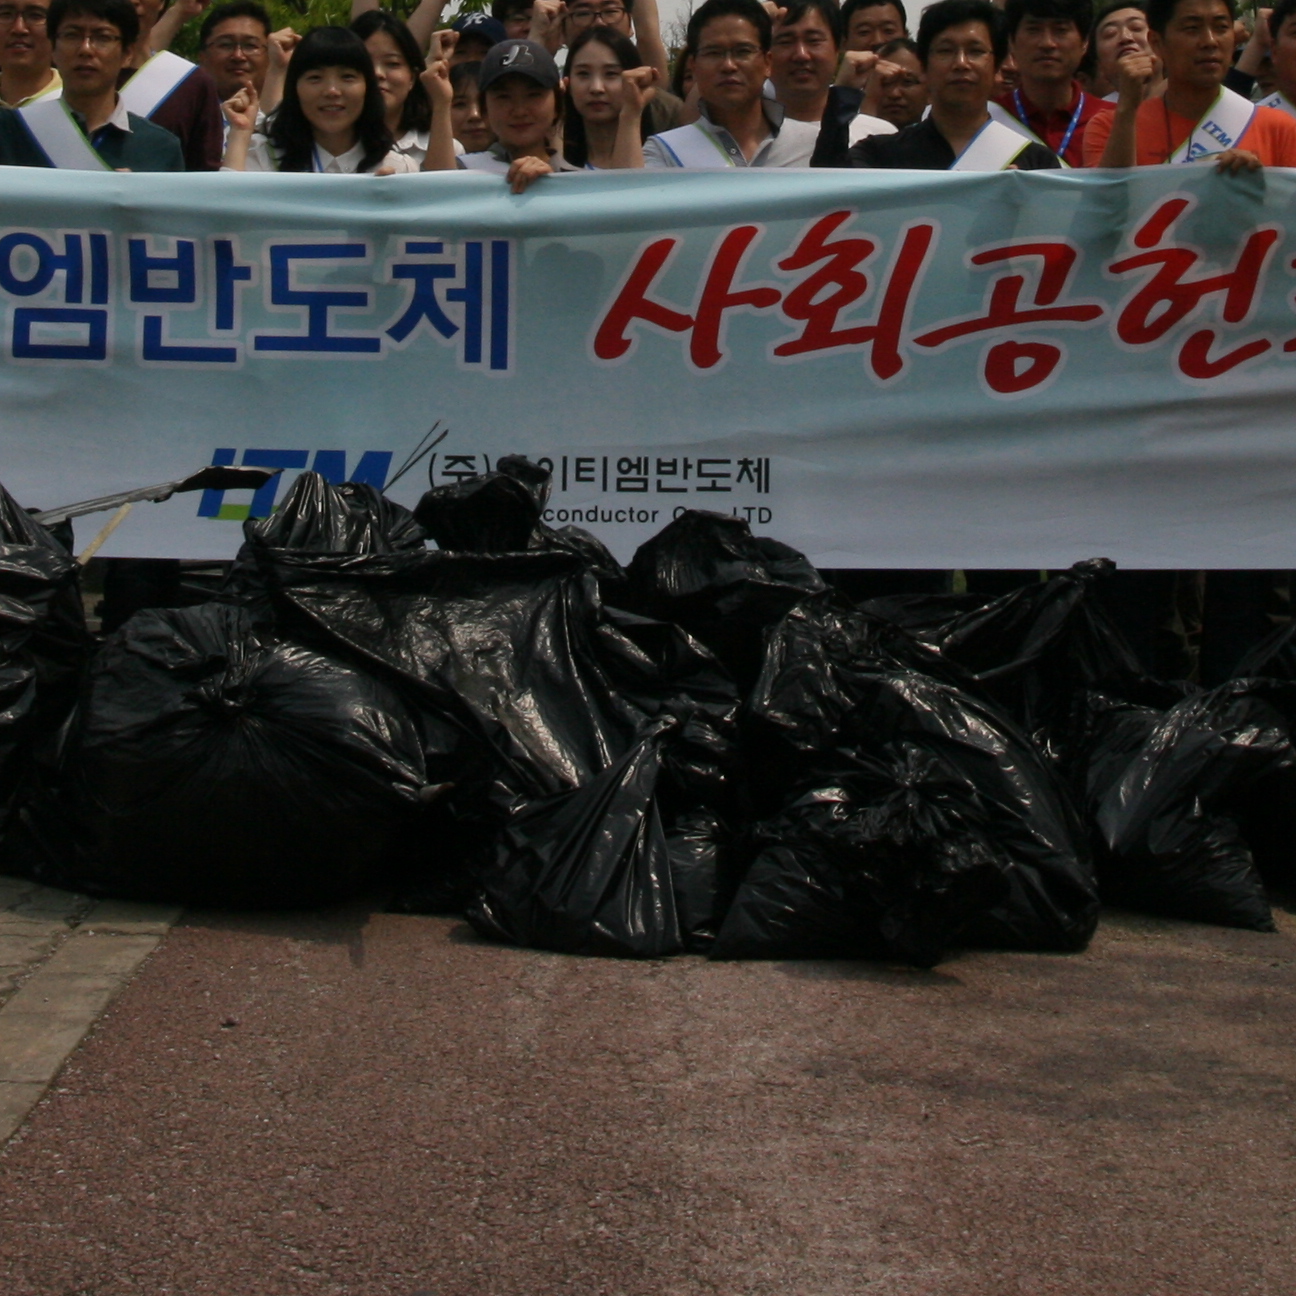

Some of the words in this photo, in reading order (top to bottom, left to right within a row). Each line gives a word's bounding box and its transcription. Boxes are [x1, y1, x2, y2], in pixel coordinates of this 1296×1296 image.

[1201, 120, 1232, 147] ITM
[429, 452, 771, 494] (주)이티엠반도체
[542, 505, 659, 524] conductor
